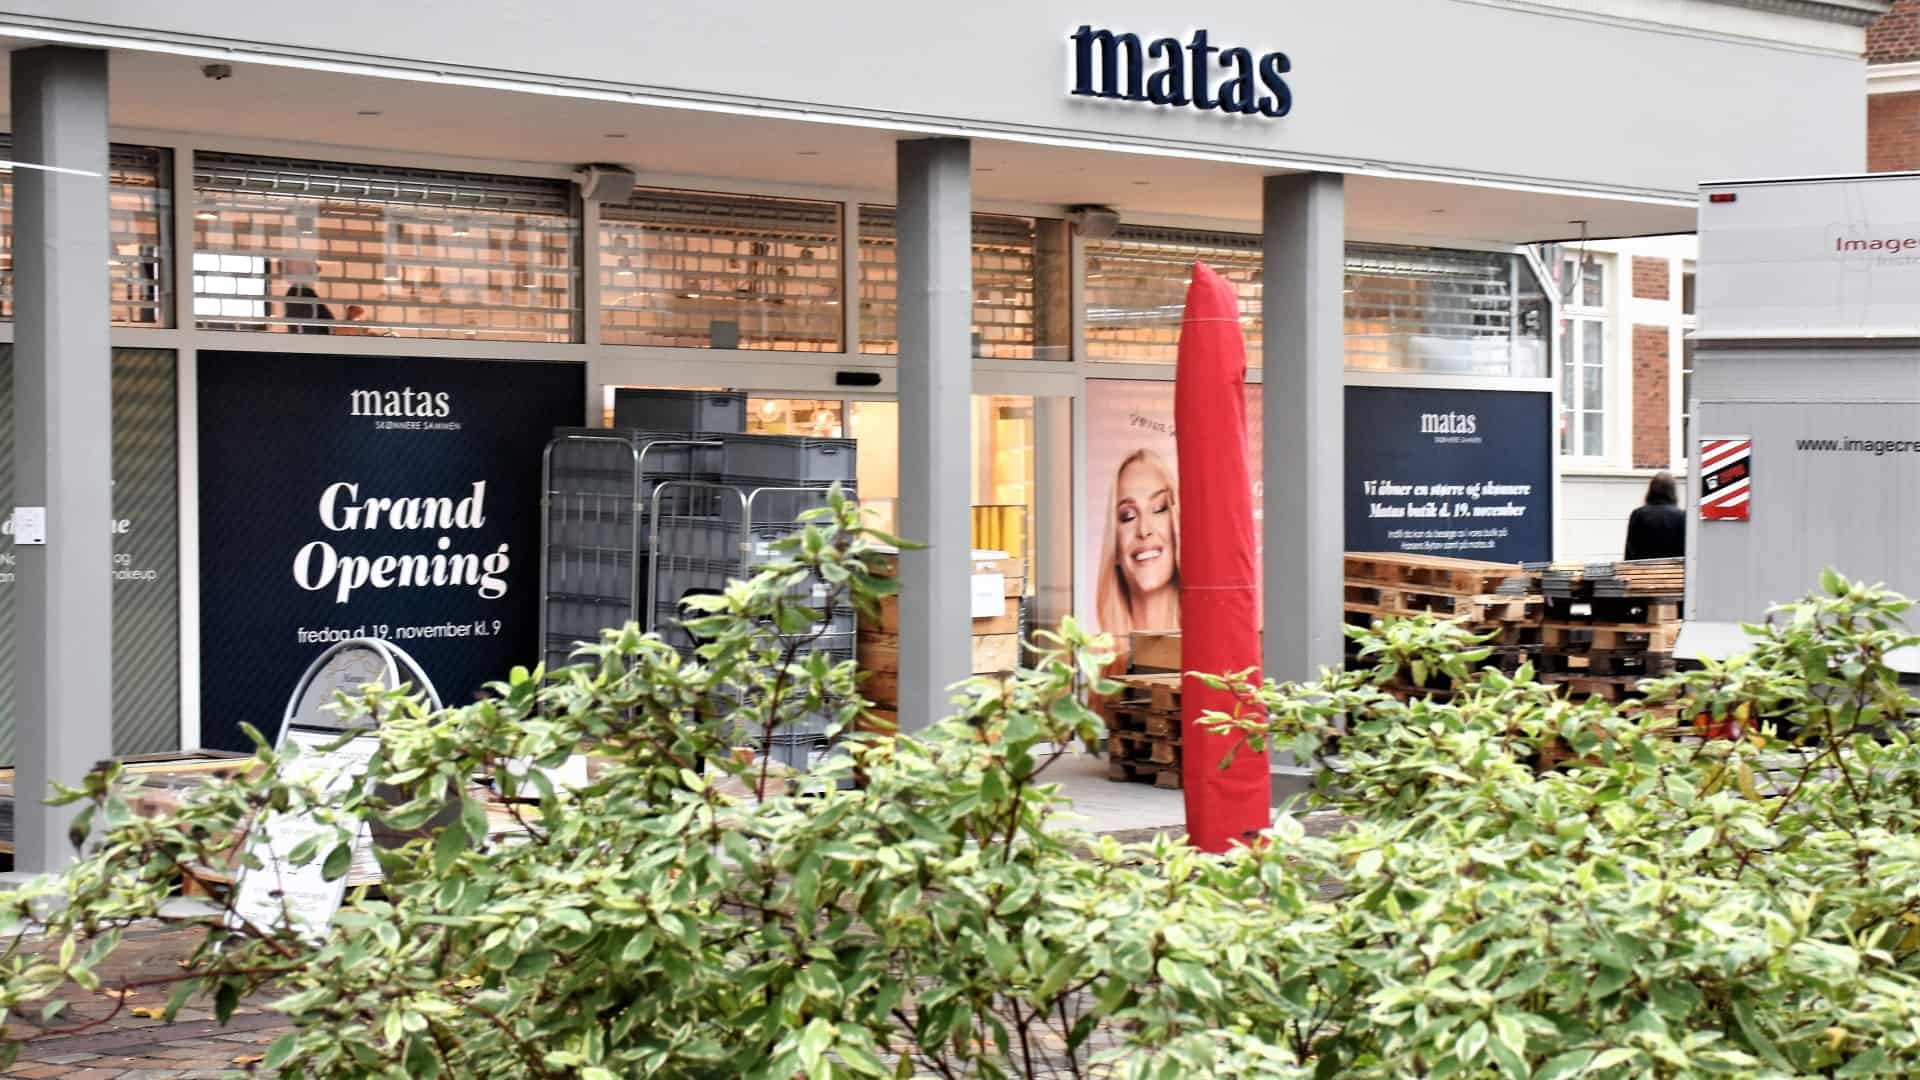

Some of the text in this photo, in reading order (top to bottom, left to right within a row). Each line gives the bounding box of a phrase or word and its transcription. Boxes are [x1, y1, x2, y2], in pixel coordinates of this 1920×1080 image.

[1070, 25, 1292, 118] matas
[1836, 237, 1920, 253] Image
[350, 386, 450, 418] matas
[1420, 411, 1476, 433] matas
[318, 480, 486, 532] Grand
[293, 536, 510, 604] Opening
[396, 621, 472, 639] november
[474, 620, 489, 636] kl.
[491, 619, 502, 636] 9
